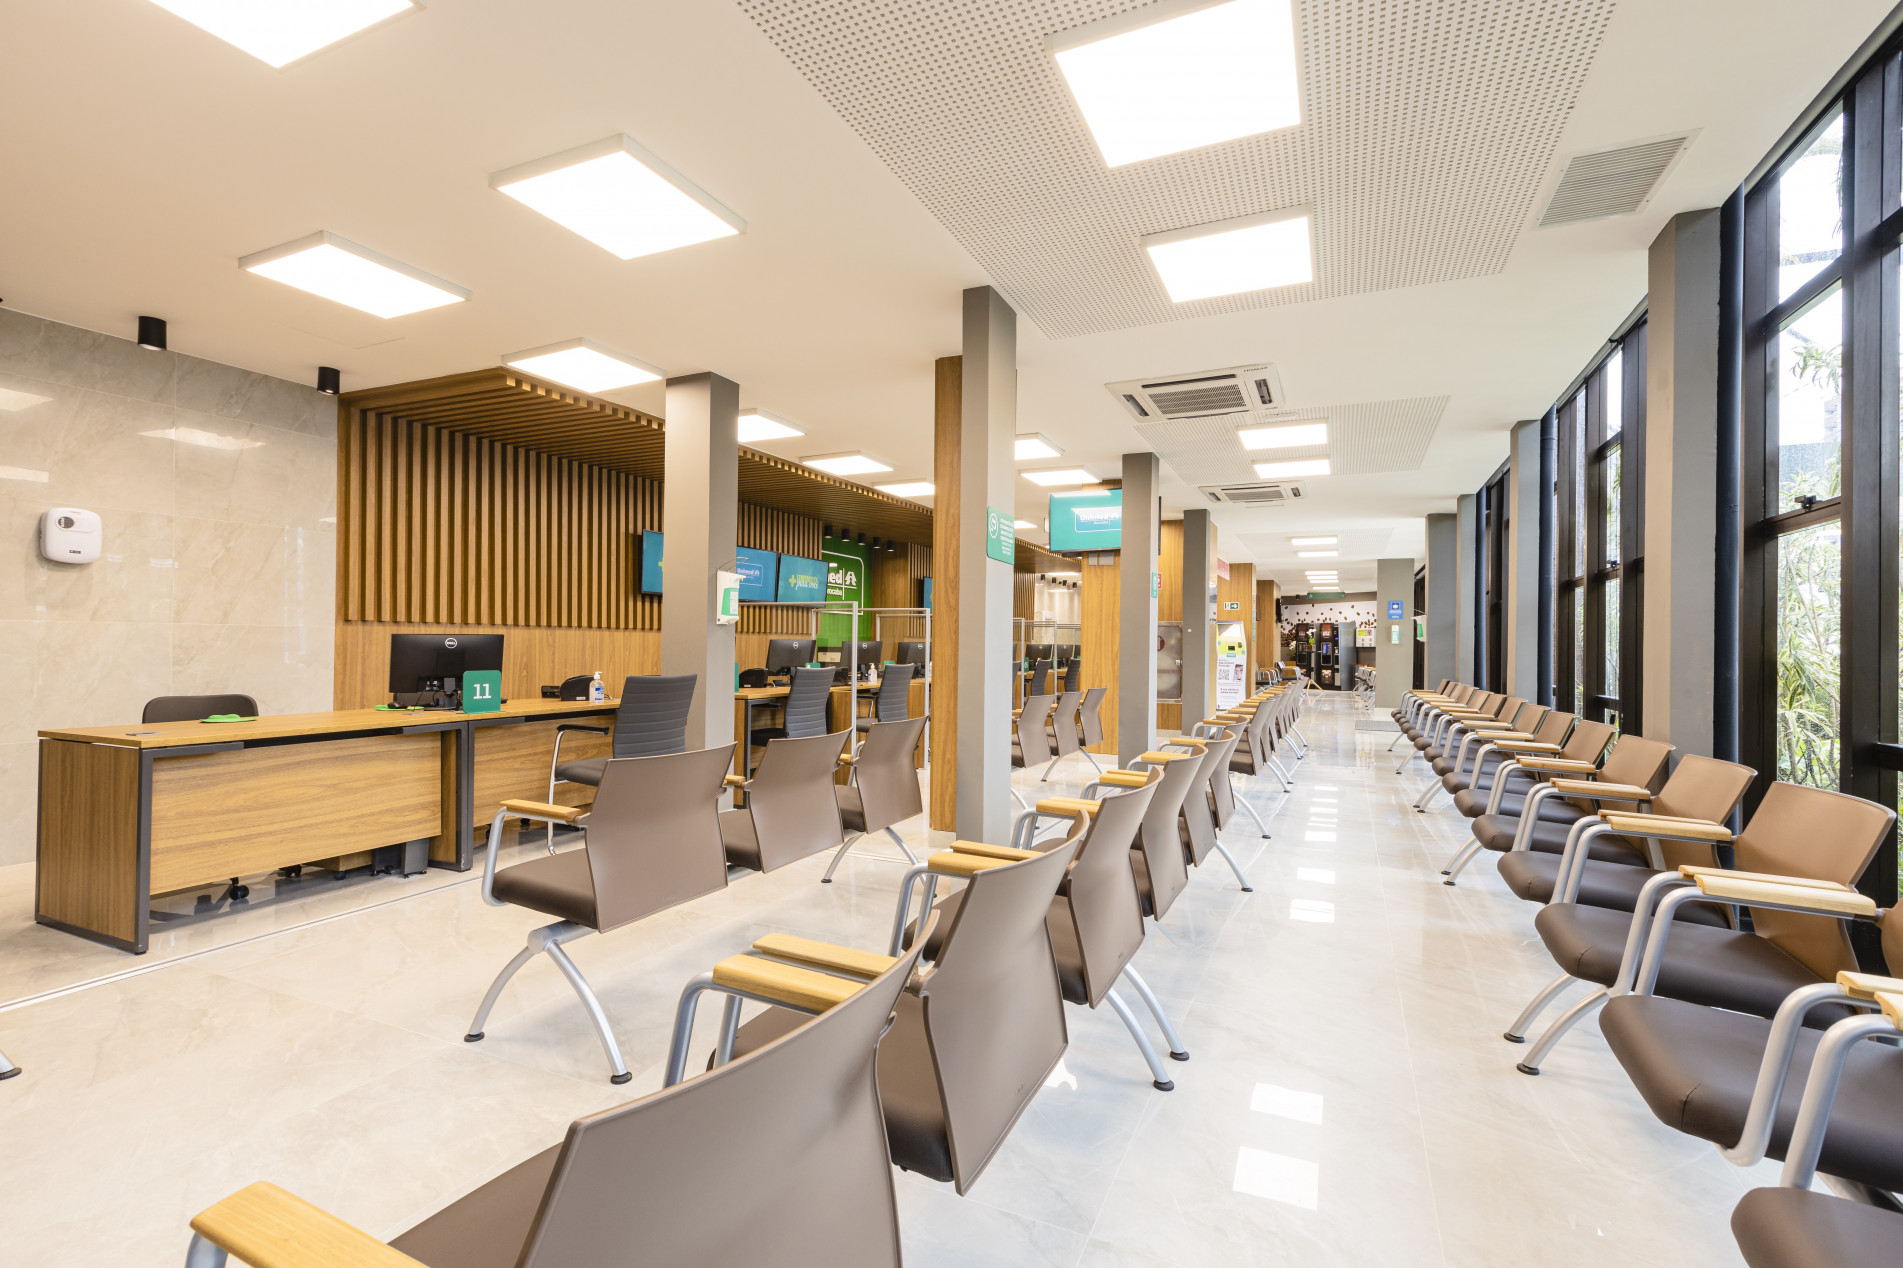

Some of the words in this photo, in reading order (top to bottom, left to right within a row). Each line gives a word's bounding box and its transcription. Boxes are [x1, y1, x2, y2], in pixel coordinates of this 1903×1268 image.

[828, 569, 843, 585] ed
[827, 587, 843, 596] rocaba
[473, 683, 492, 700] 11
